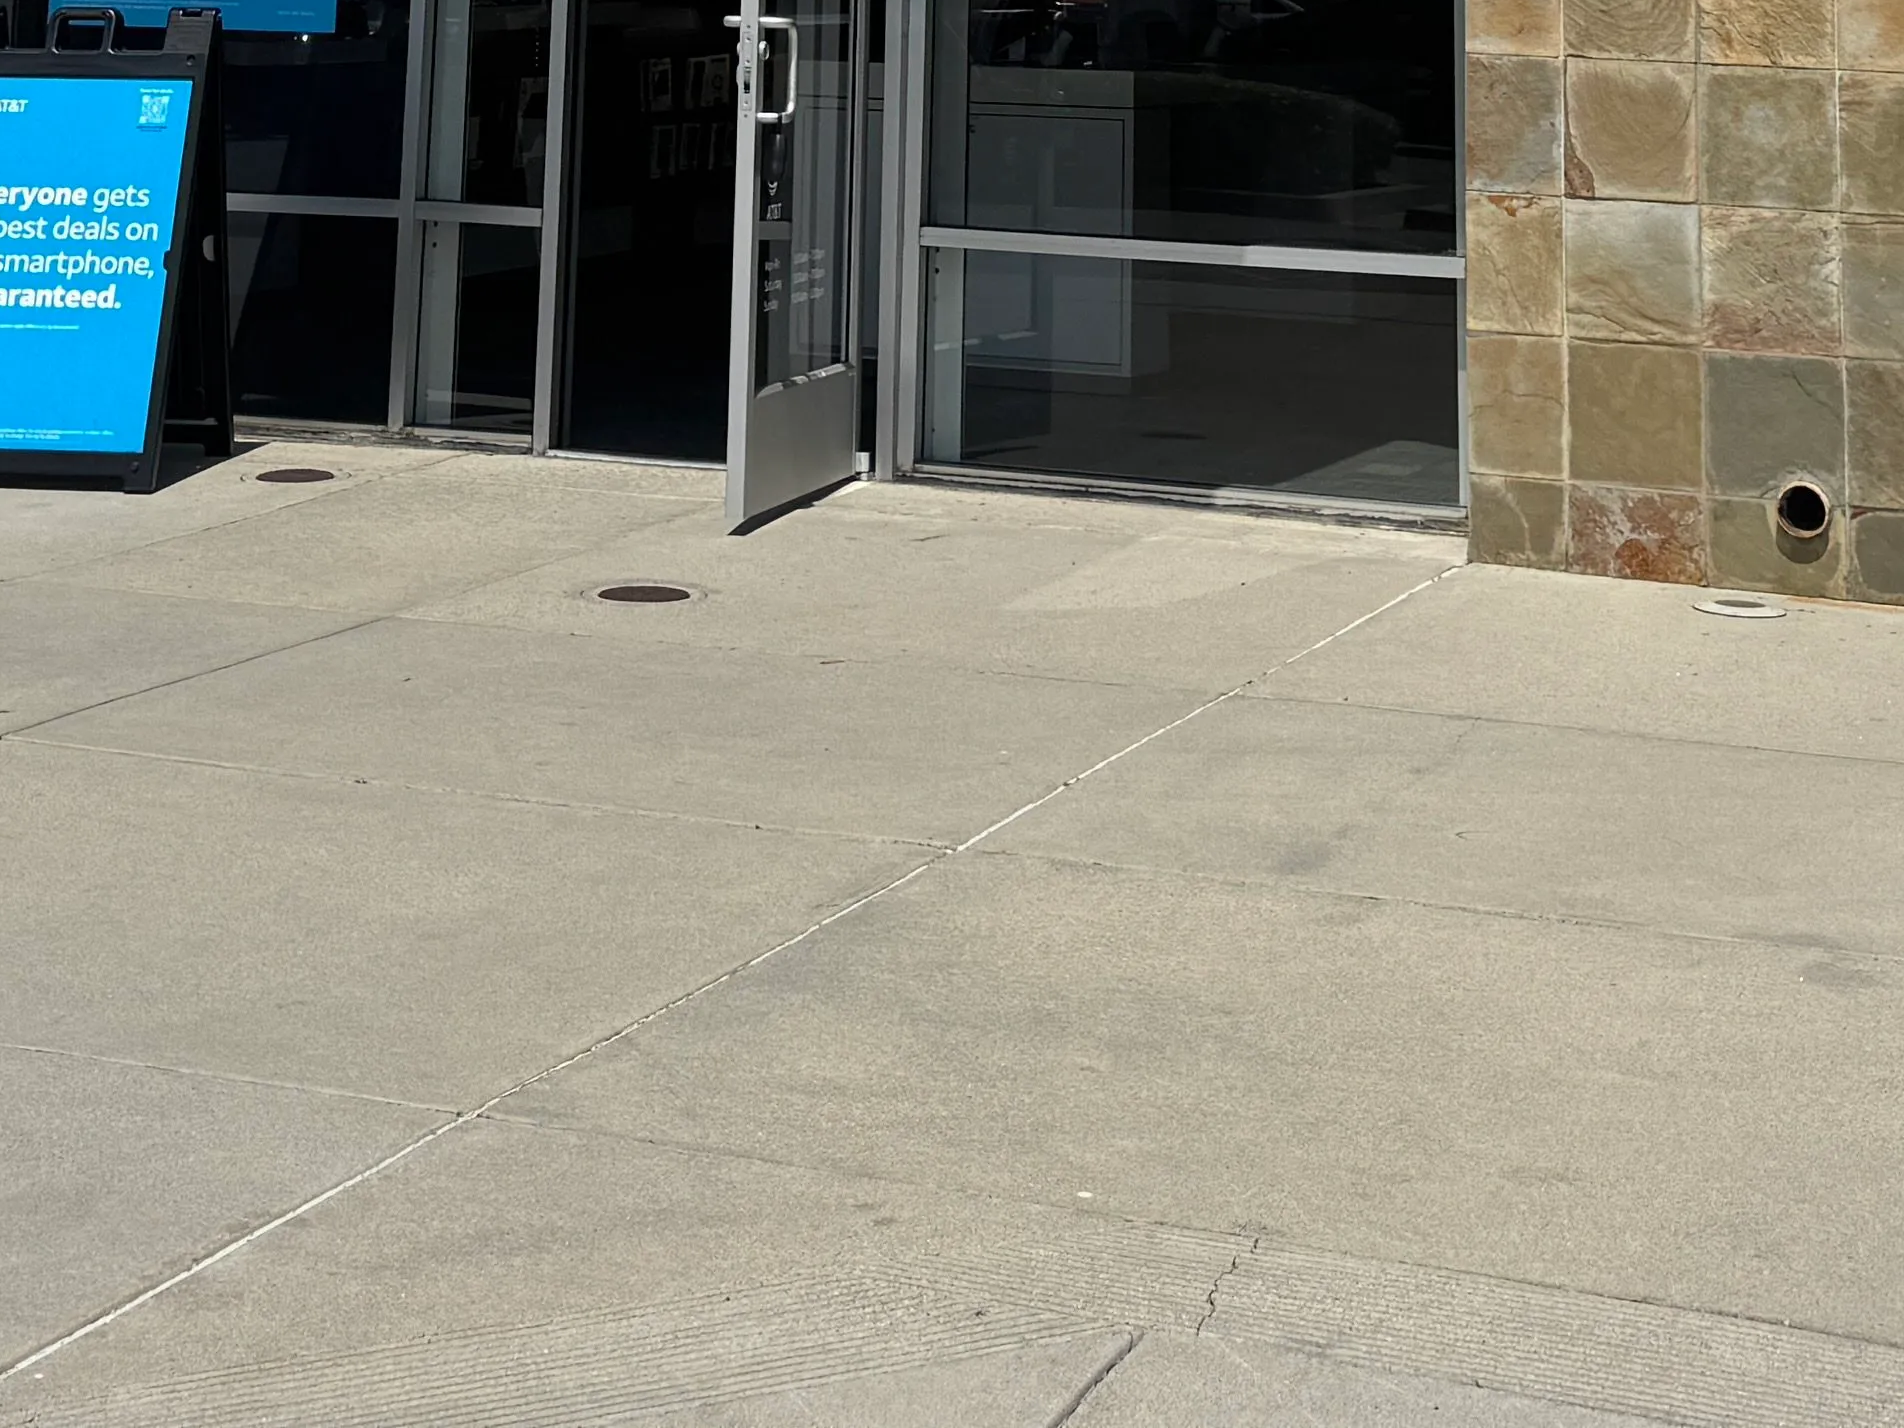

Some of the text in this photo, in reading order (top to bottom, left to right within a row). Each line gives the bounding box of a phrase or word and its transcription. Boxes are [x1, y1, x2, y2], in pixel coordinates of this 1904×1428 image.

[93, 184, 151, 213] gets
[52, 214, 121, 241] deals
[125, 222, 159, 242] on
